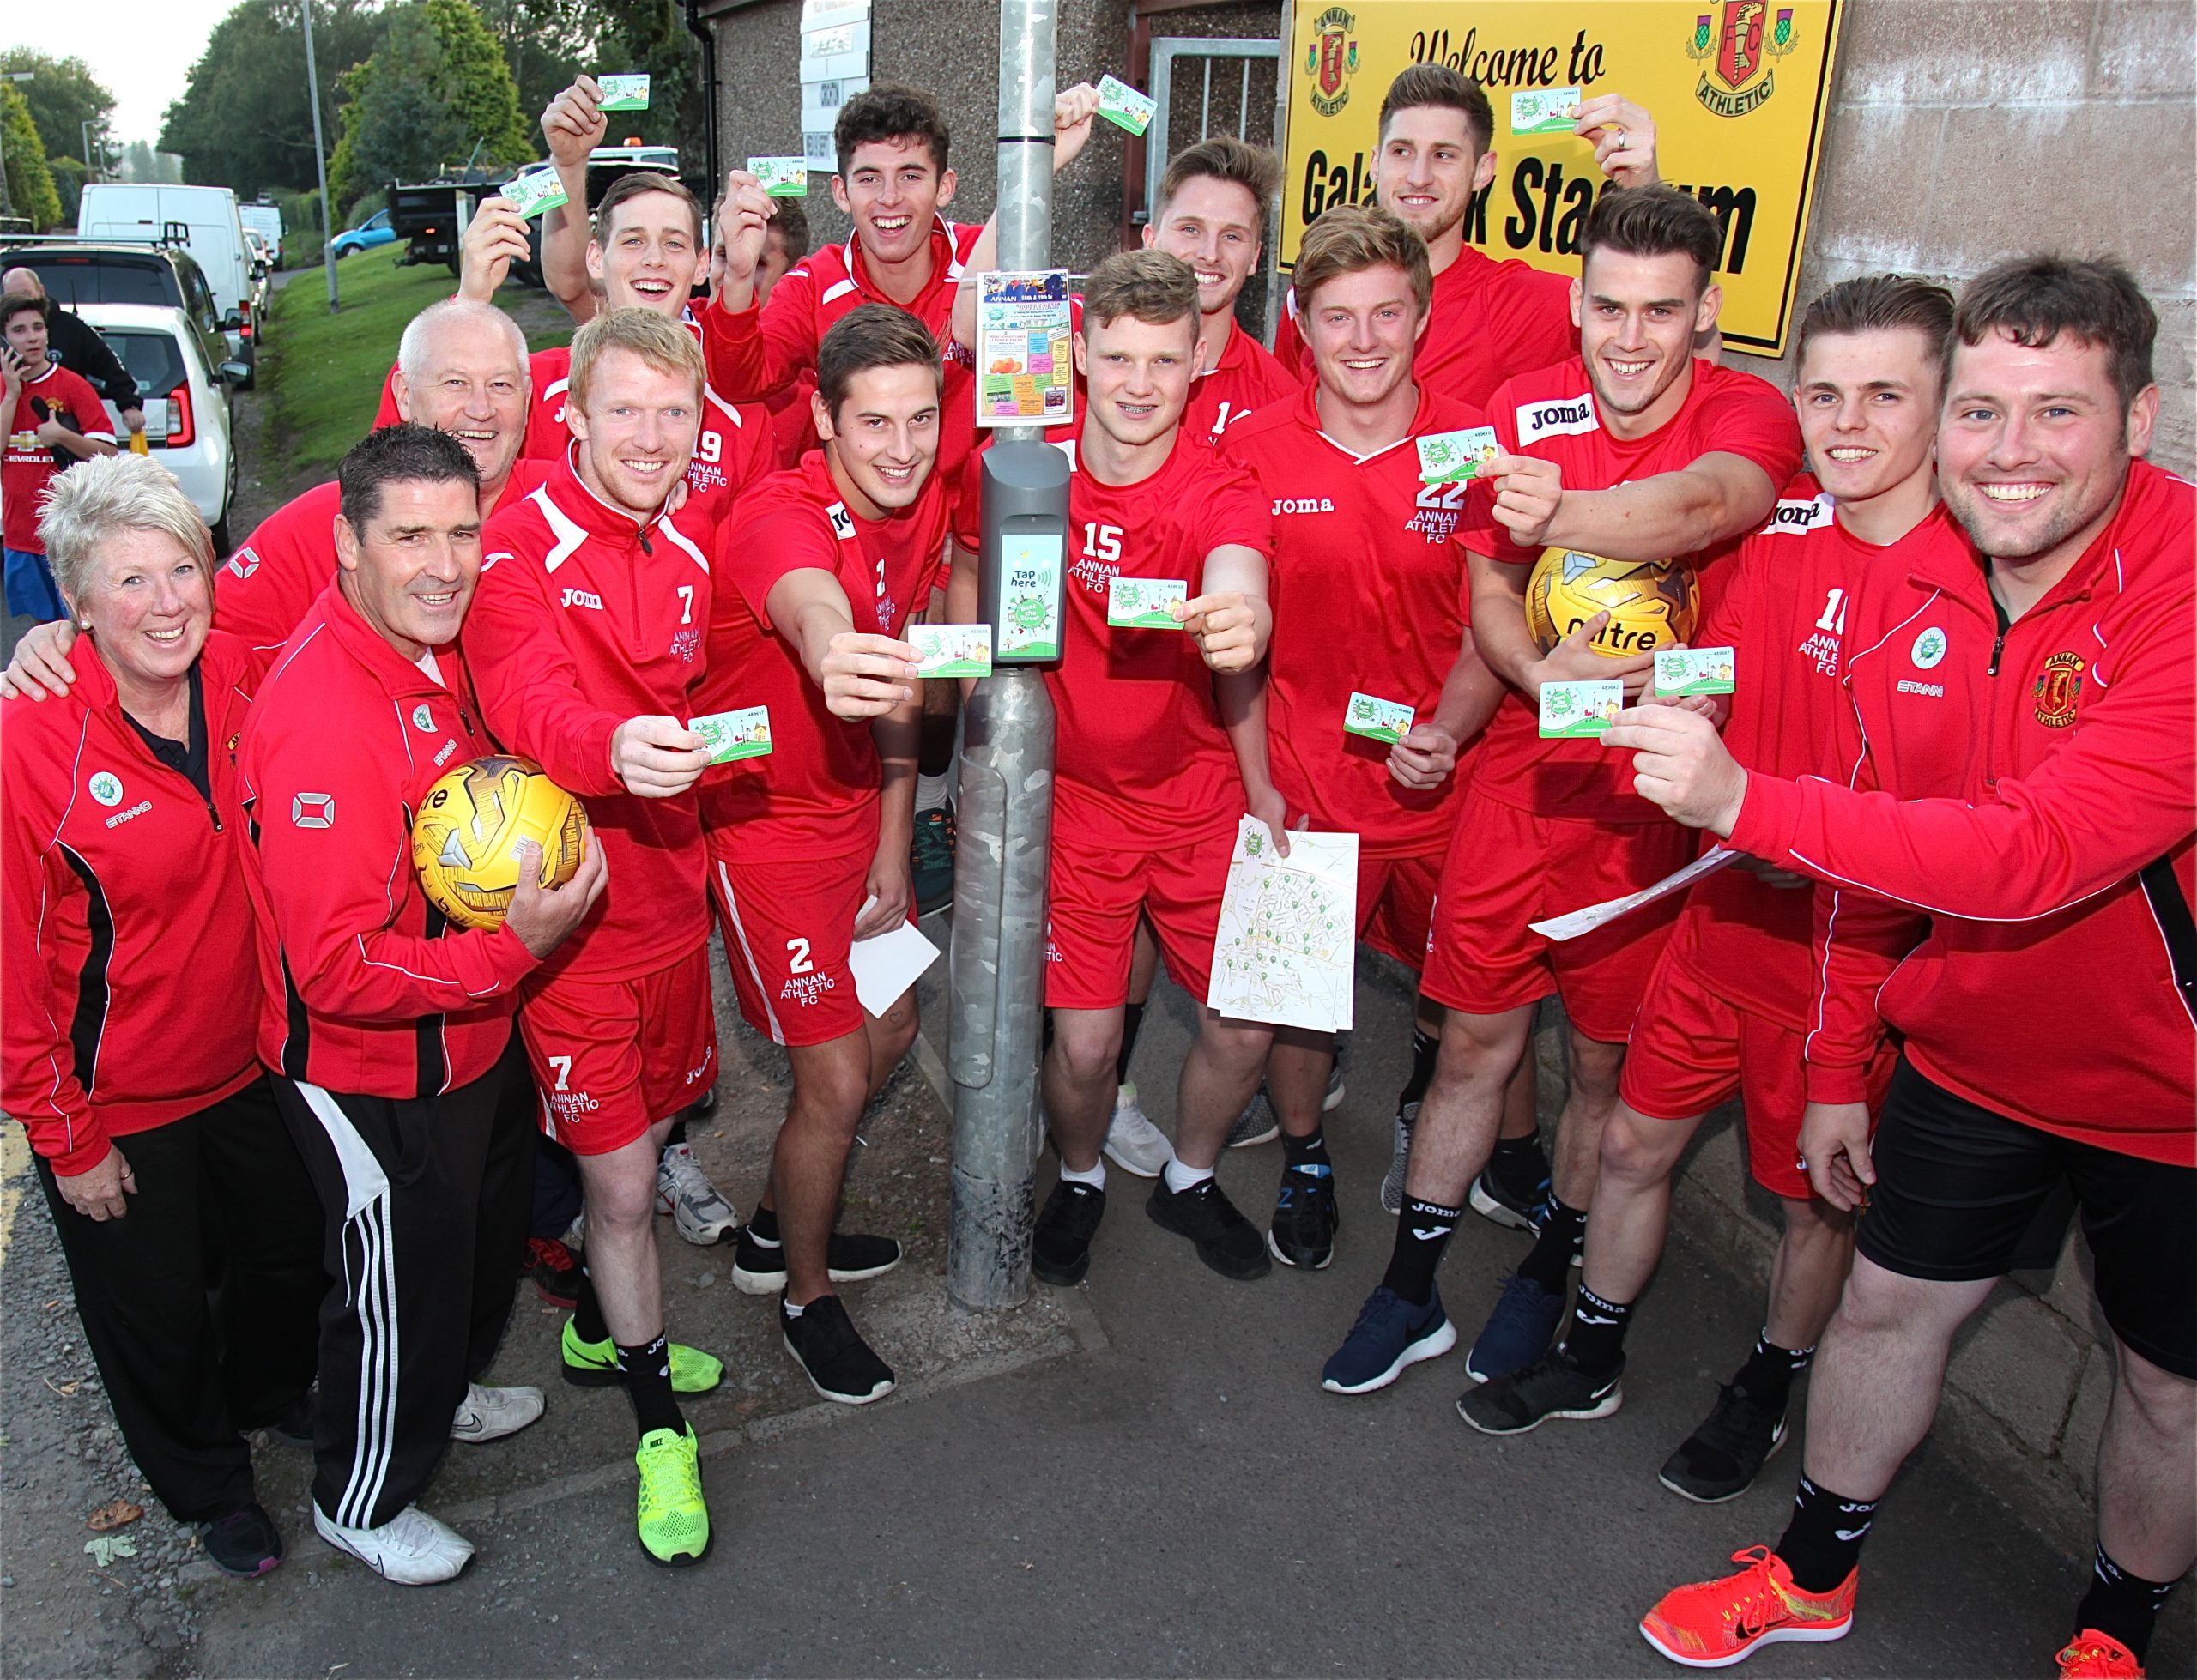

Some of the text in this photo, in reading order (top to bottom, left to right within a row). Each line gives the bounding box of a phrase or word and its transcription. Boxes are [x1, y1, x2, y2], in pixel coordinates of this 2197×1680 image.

[1320, 9, 1350, 28] ANNAN
[1410, 27, 1606, 88] Welcome to
[1311, 91, 1347, 115] ATHLETIC
[1698, 82, 1770, 114] ATHLETIC
[1532, 402, 1590, 430] Joma
[687, 470, 728, 486] HLETIC
[692, 480, 708, 493] FC
[1271, 497, 1335, 516] Joma
[1404, 520, 1456, 534] ATHLET
[1083, 522, 1123, 562] 15
[1426, 533, 1445, 544] FC
[1014, 570, 1036, 580] Tap
[1068, 566, 1114, 583] ATHLE
[1075, 558, 1120, 577] ANNAN
[1010, 577, 1037, 588] here
[1086, 582, 1104, 593] FC
[560, 588, 604, 610] Jom
[676, 585, 693, 625] 7
[1020, 603, 1038, 612] Beat
[1815, 588, 1849, 636] 1
[1807, 632, 1840, 653] ANN
[1797, 641, 1837, 665] ATHLE
[1816, 662, 1836, 676] FC
[2035, 708, 2075, 728] ATHLETIC
[105, 800, 153, 829] STANNO
[786, 937, 814, 974] 2
[780, 978, 835, 1000] ATHLETIC
[784, 971, 826, 989] ANNAN
[800, 995, 818, 1007] FC
[548, 1055, 572, 1091] 7
[550, 1091, 589, 1104] ANNAN
[563, 1114, 581, 1123] FC
